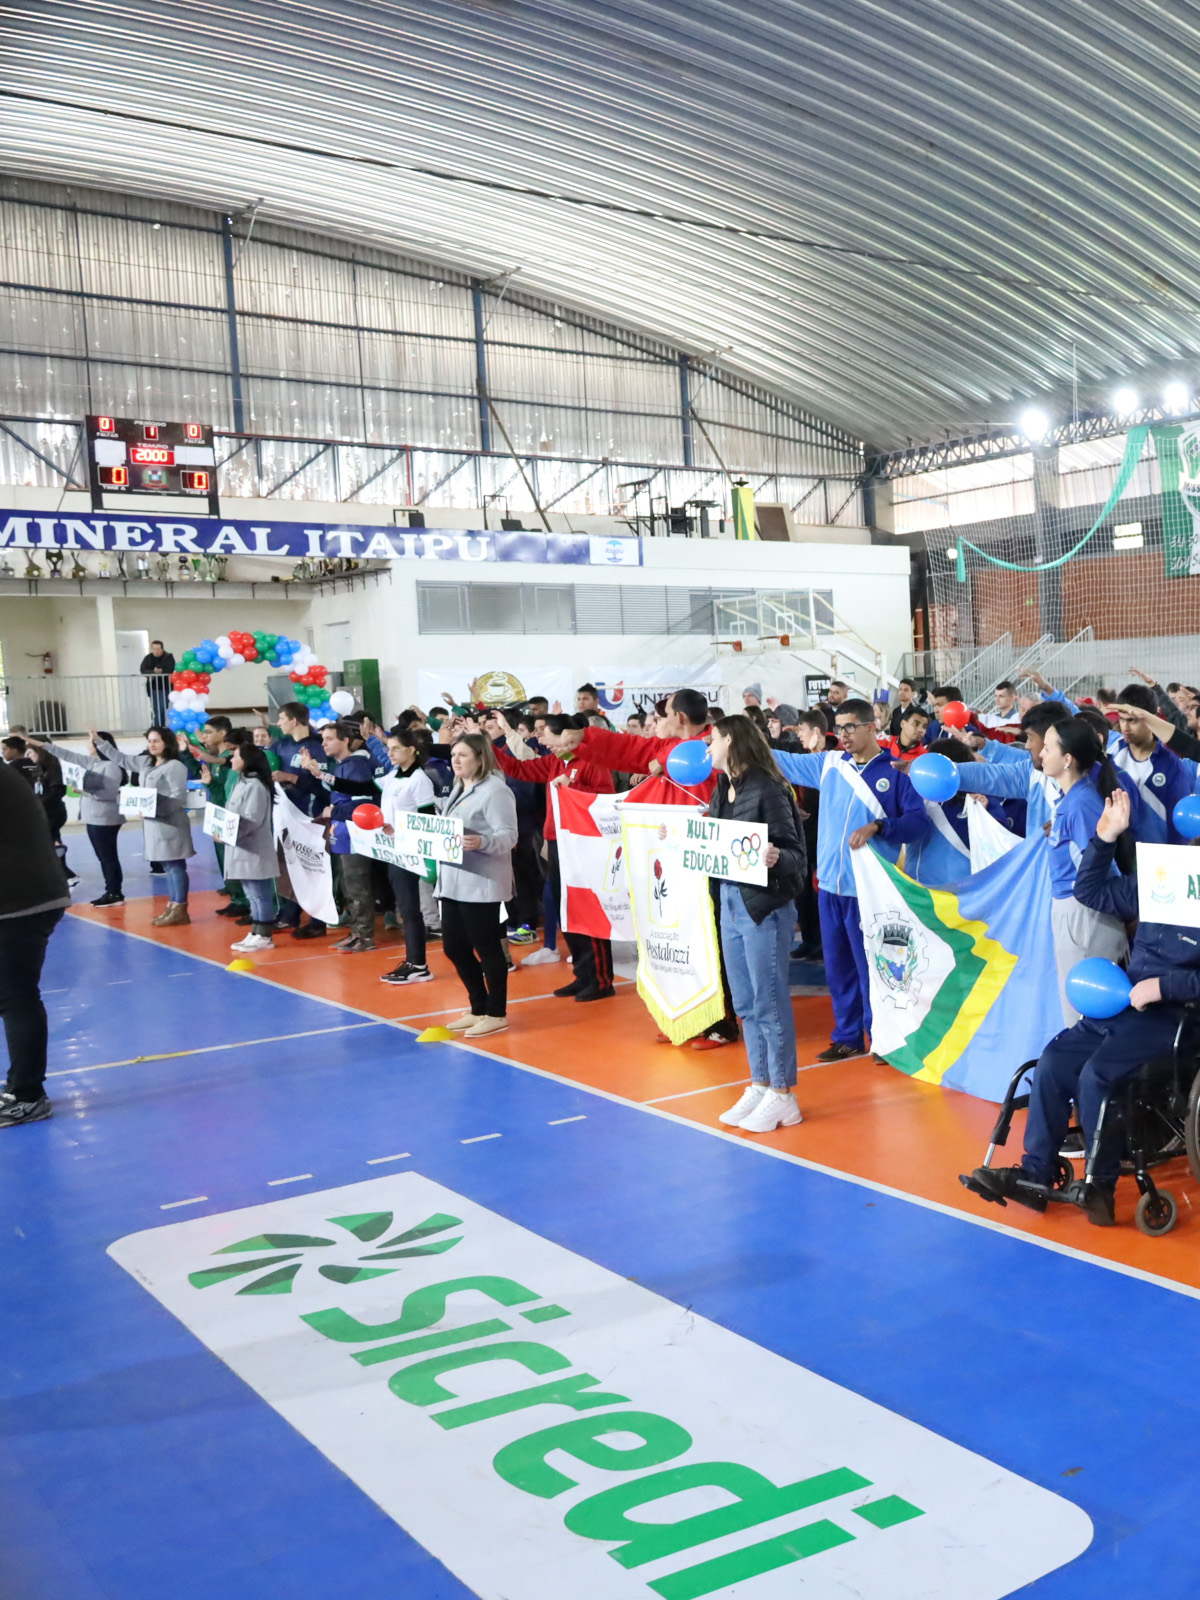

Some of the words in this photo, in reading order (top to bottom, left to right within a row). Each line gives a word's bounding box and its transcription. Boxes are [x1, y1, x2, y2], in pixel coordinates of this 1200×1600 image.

[101, 417, 110, 430] 0
[188, 424, 199, 437] 0
[111, 467, 125, 484] 0
[193, 471, 206, 489] 0
[0, 516, 290, 555] MINERAL
[304, 529, 491, 562] ITAIPU
[407, 814, 456, 836] PESTALOZZI
[686, 818, 720, 841] MULTI
[418, 838, 433, 857] SMI
[683, 850, 729, 876] EDUCAR
[646, 939, 689, 964] Pestalozzi
[299, 1276, 926, 1600] Sicredi
